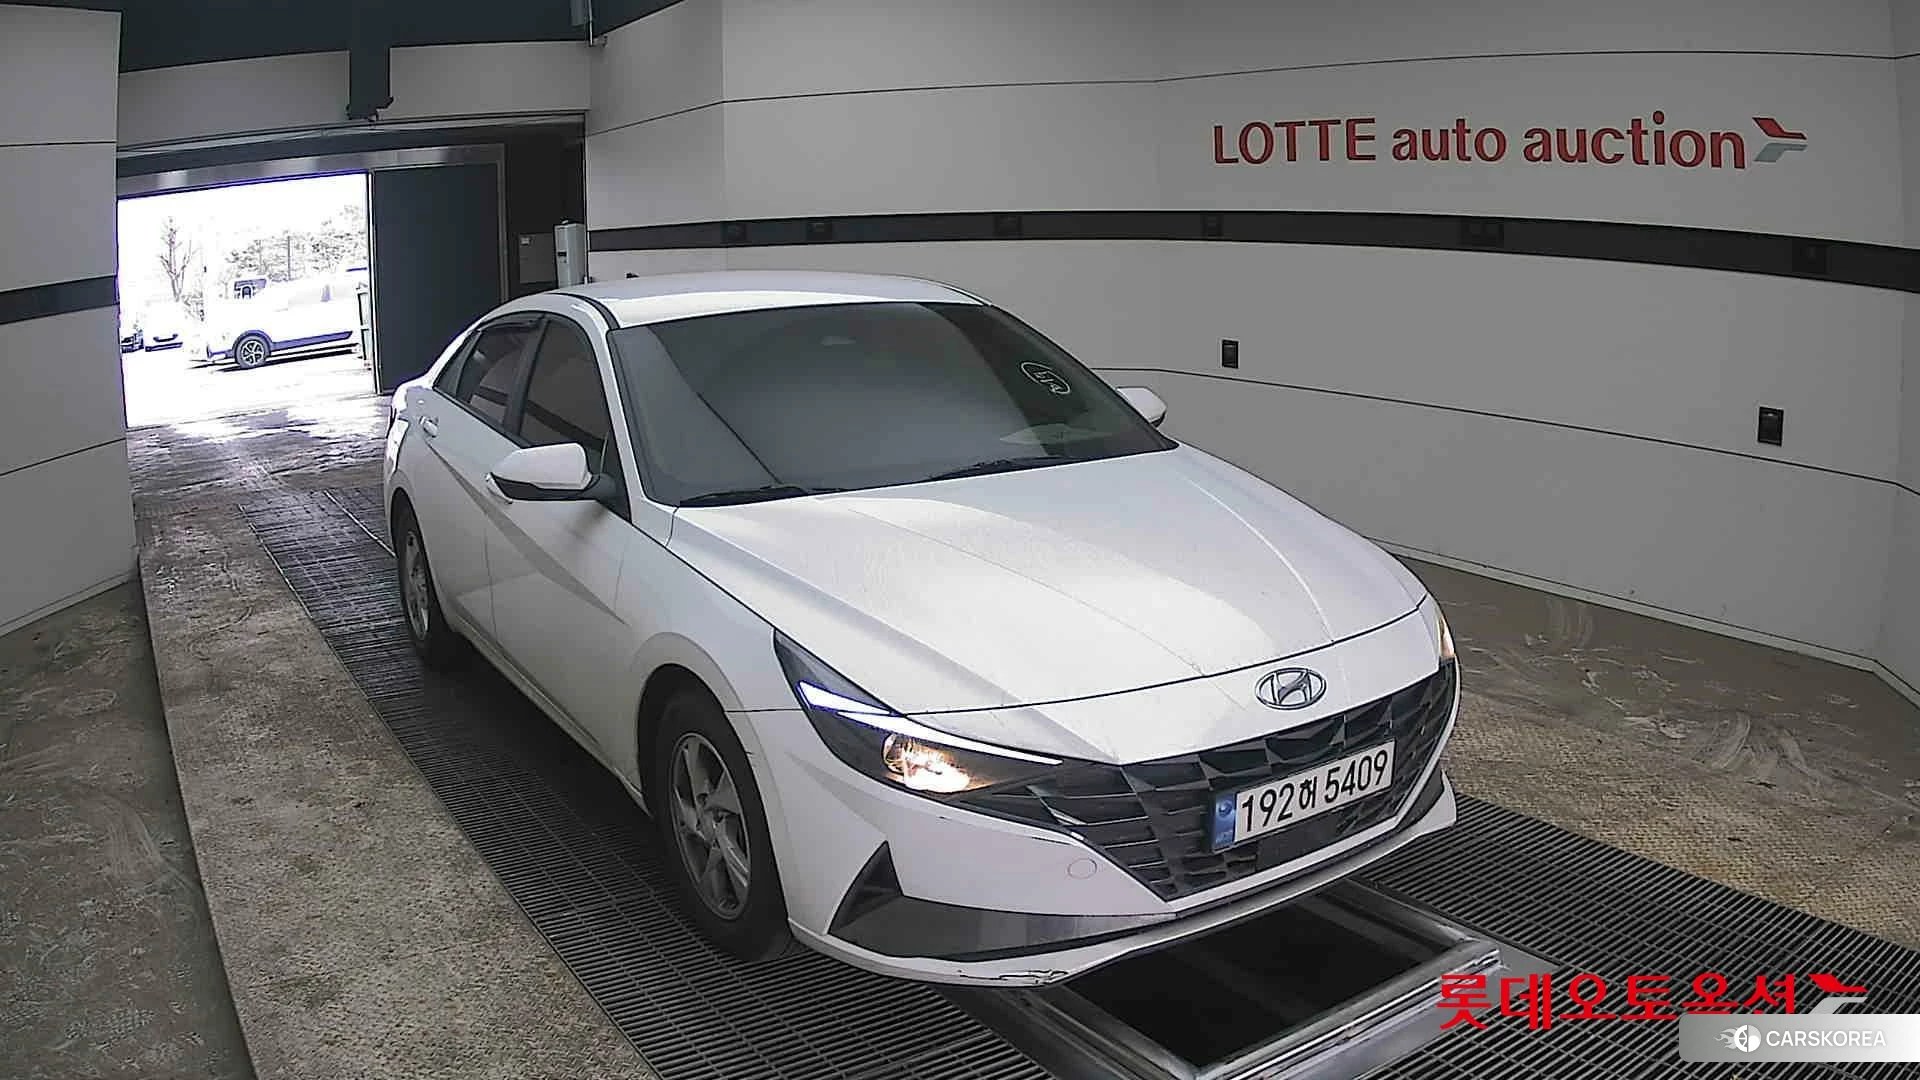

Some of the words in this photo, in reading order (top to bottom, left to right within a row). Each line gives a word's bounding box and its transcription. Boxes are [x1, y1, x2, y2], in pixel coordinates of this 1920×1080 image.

[1213, 117, 1376, 164] LOTTE
[1392, 117, 1507, 163] auto
[1523, 110, 1746, 169] auction
[1323, 750, 1388, 803] 5409
